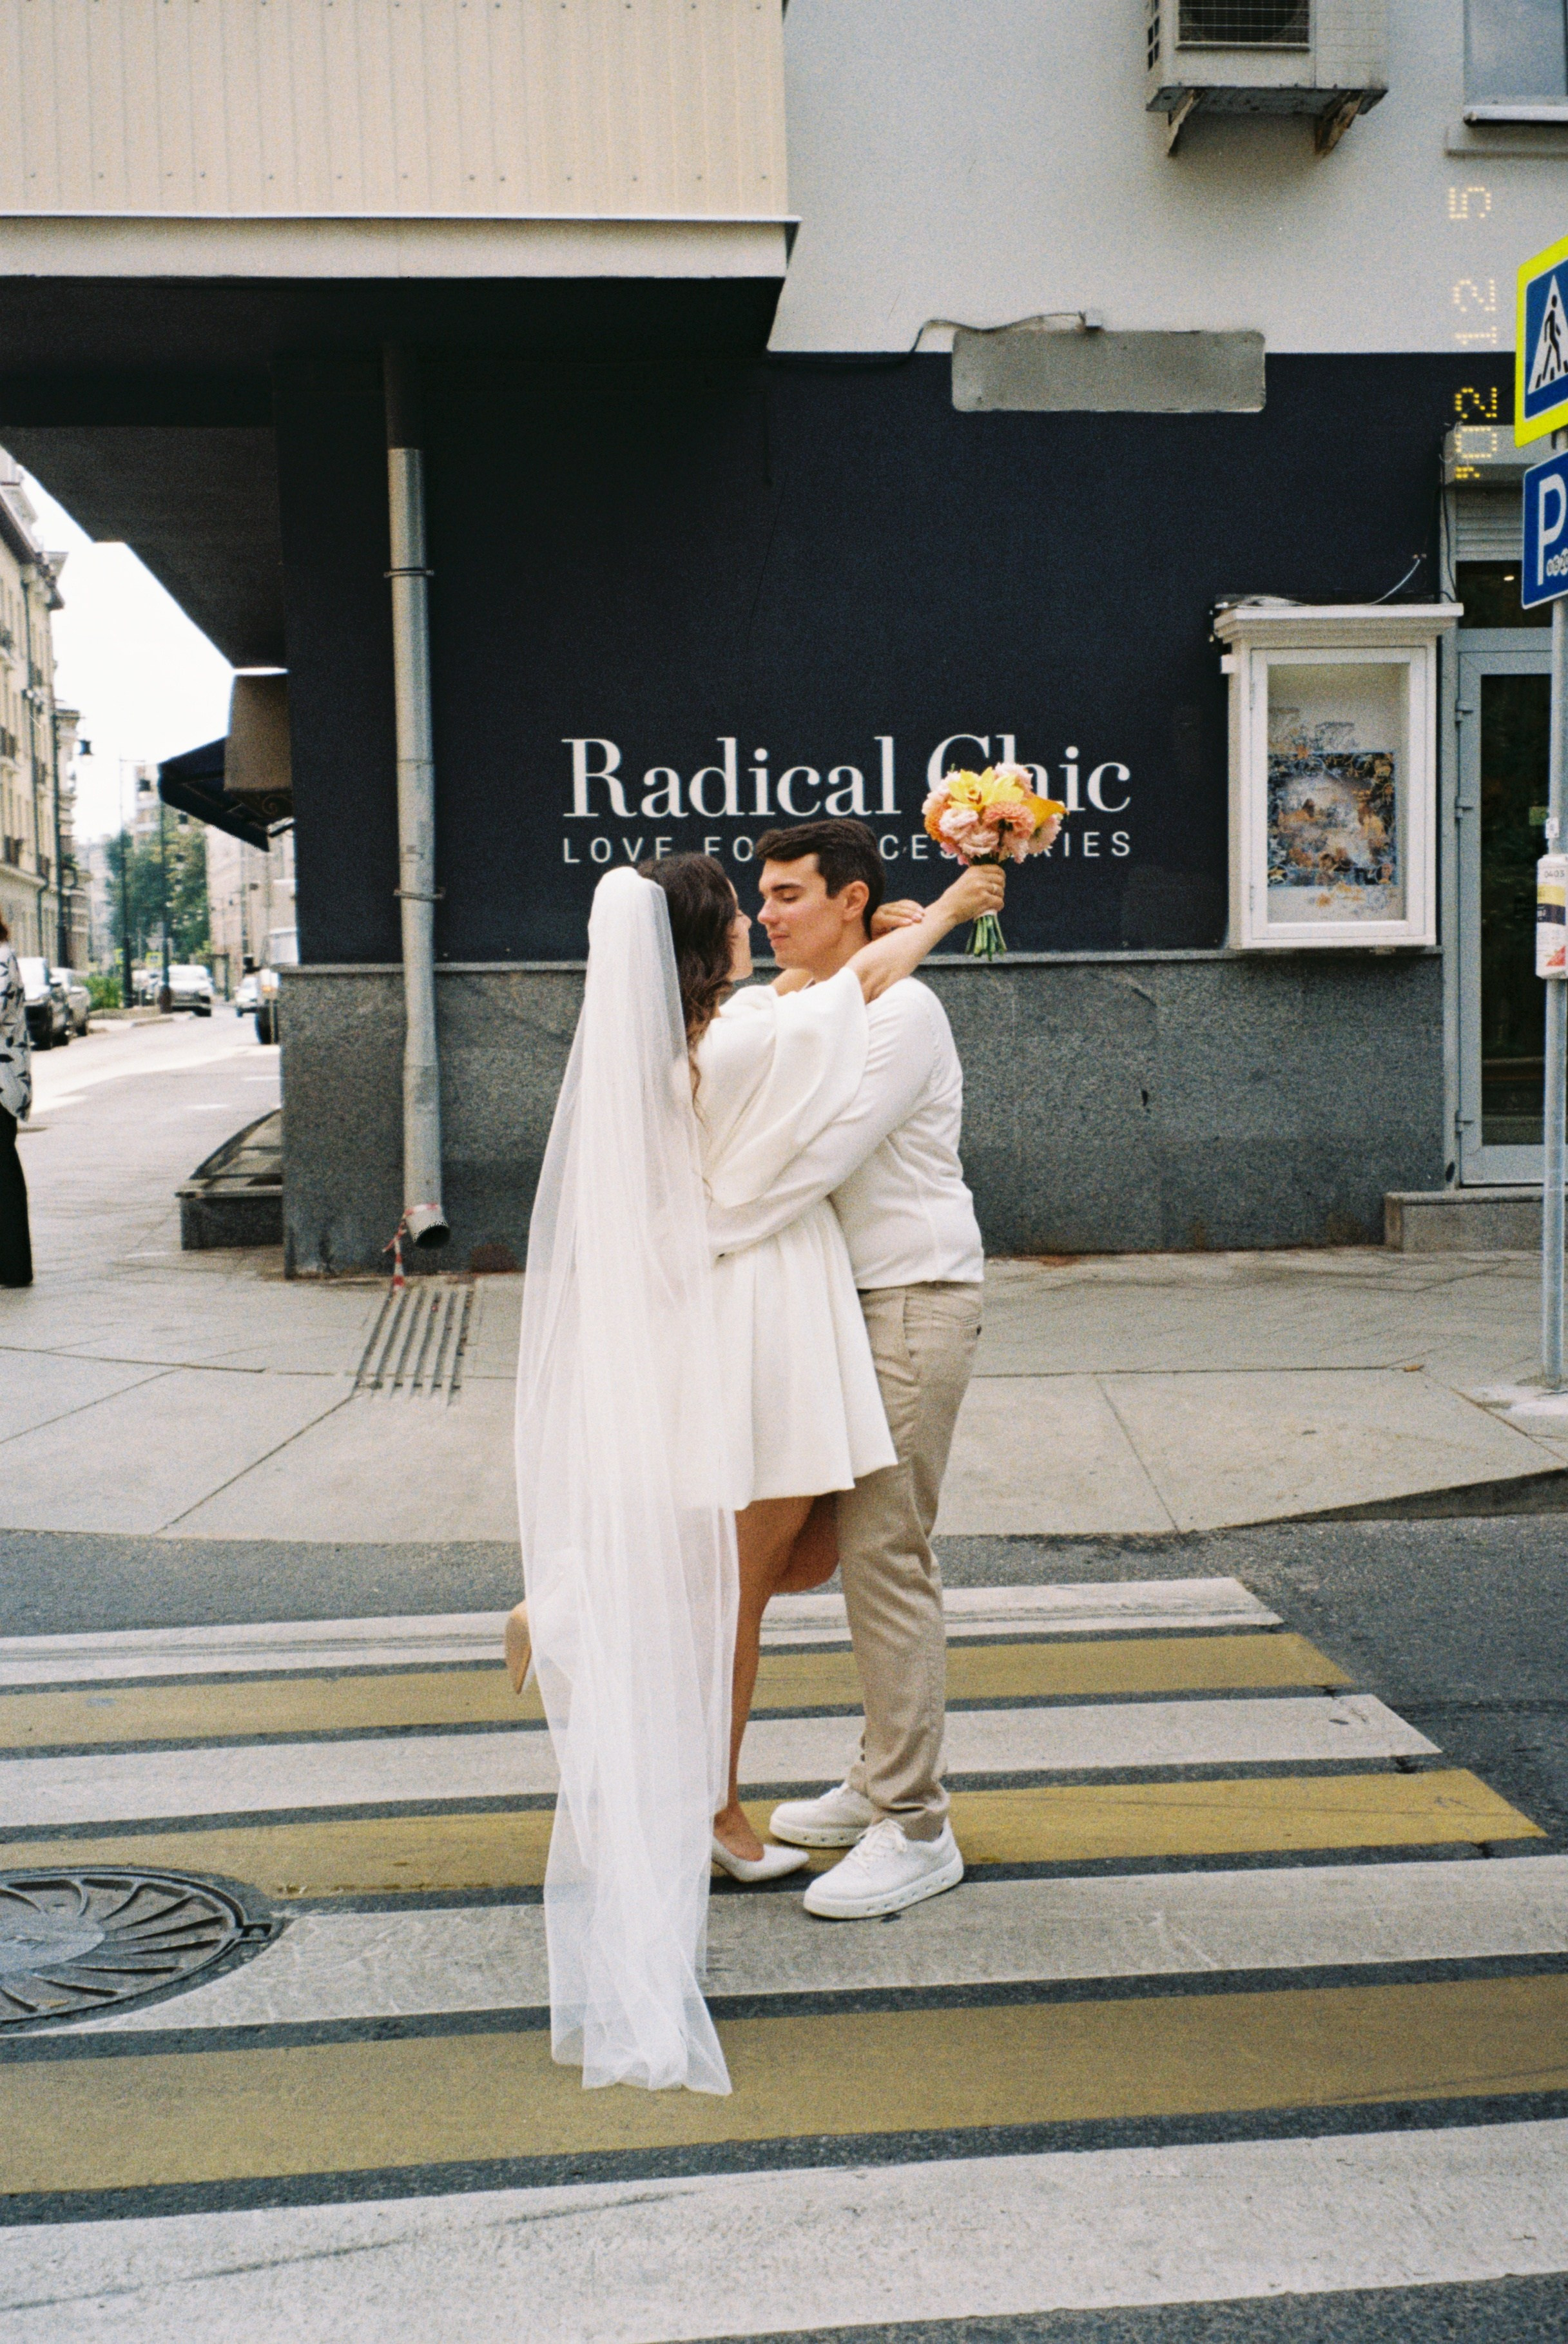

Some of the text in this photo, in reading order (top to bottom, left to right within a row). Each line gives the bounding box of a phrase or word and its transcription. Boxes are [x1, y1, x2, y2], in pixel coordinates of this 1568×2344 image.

[1537, 473, 1567, 586] P
[561, 736, 902, 818] Radical
[704, 836, 754, 862] FO
